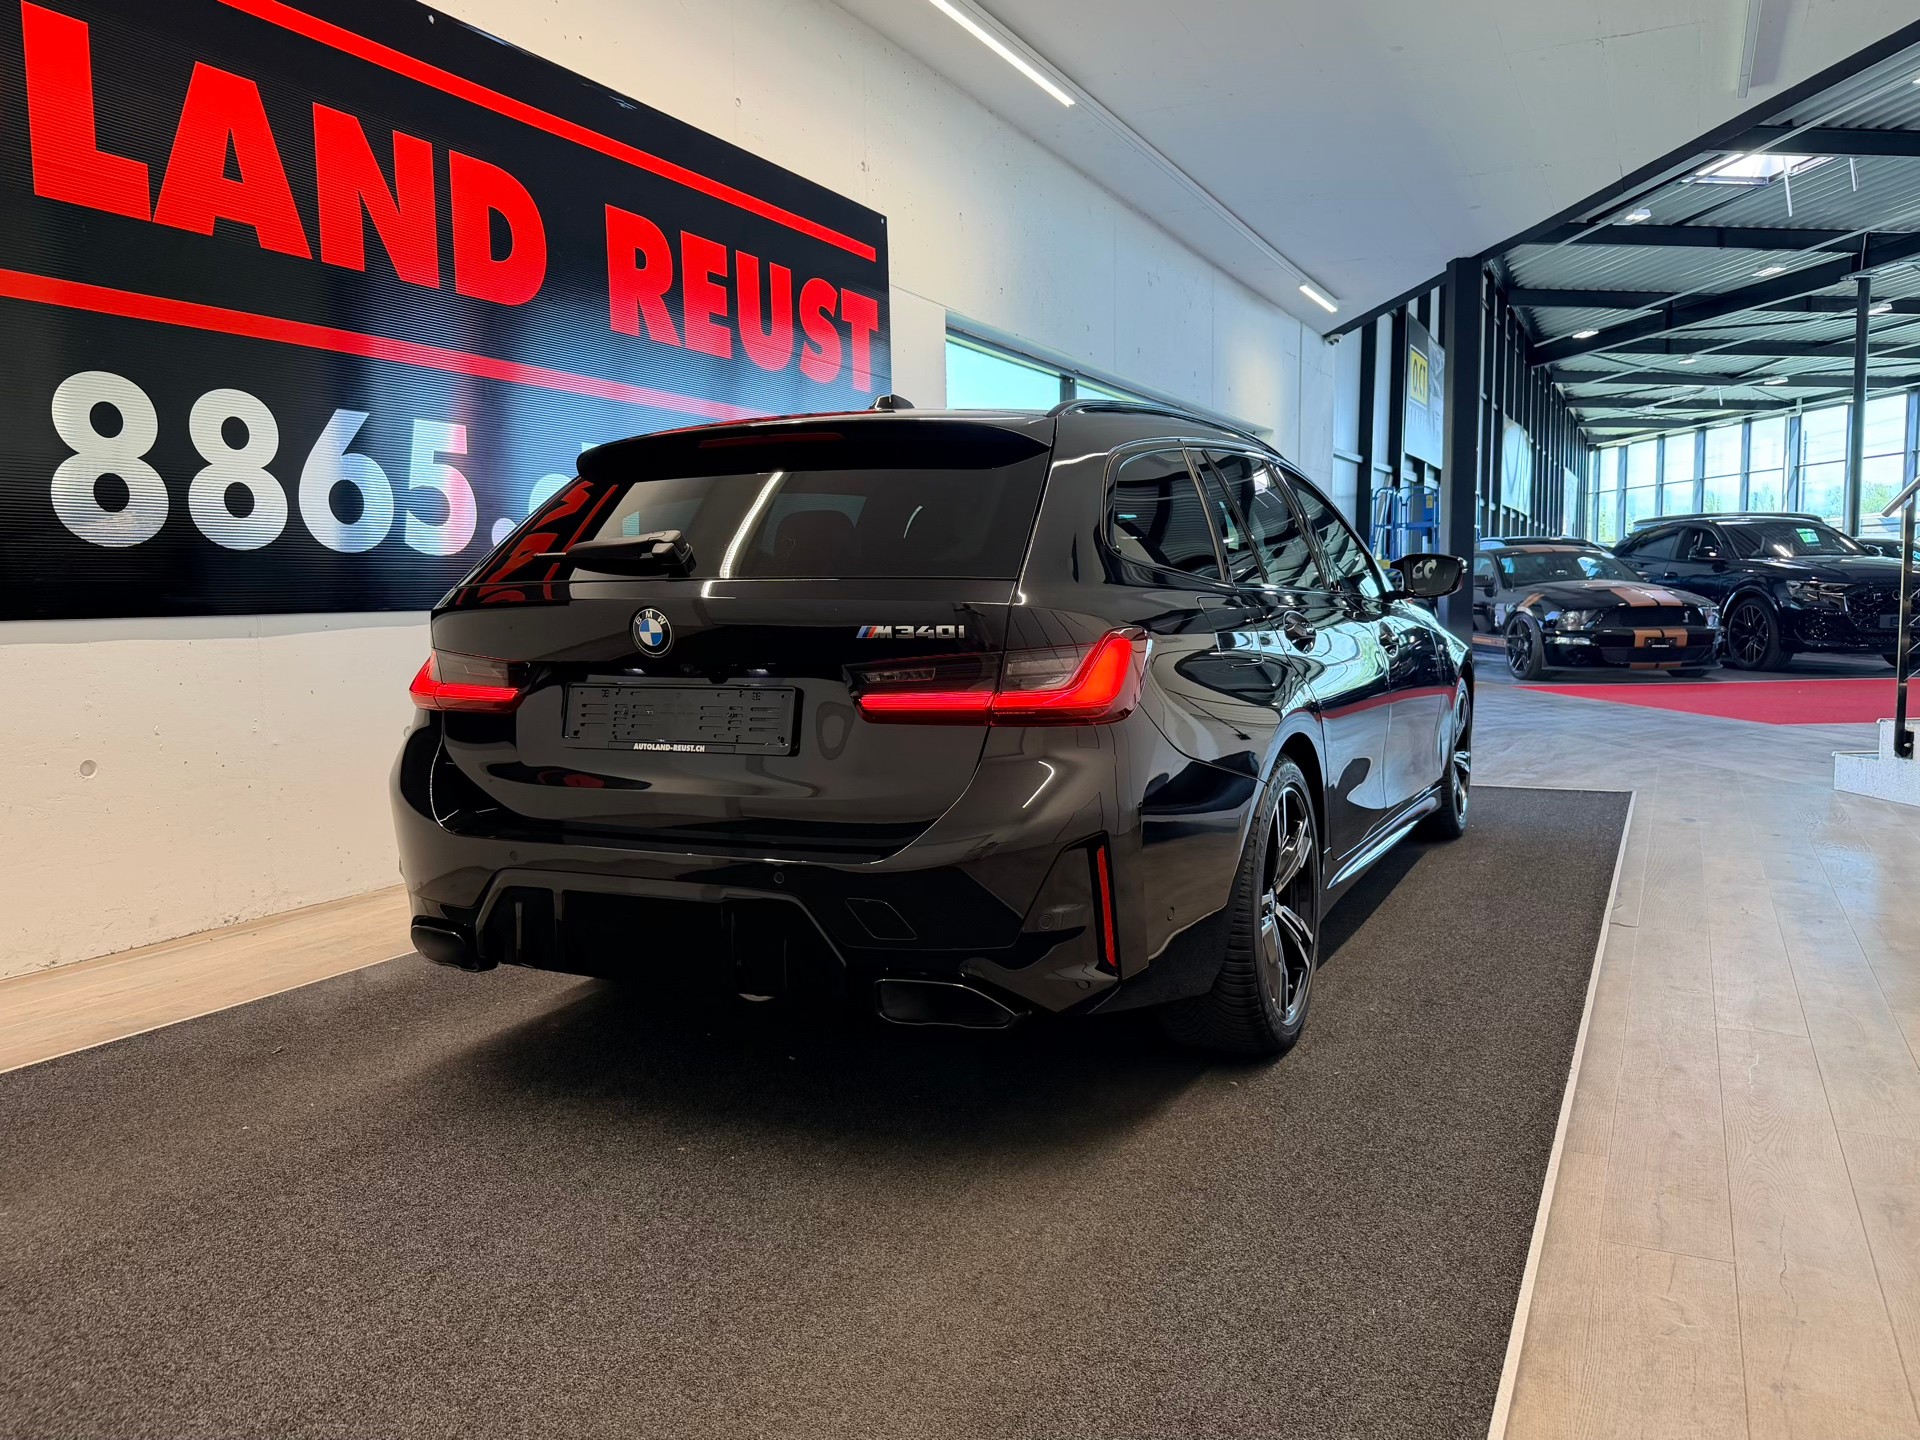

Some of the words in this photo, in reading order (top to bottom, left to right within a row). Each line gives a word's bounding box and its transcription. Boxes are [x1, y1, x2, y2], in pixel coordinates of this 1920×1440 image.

[21, 0, 547, 306] LAND
[605, 203, 879, 394] REUST
[635, 610, 667, 625] BMW
[633, 743, 706, 753] AUTOLAND-REUST.CH
